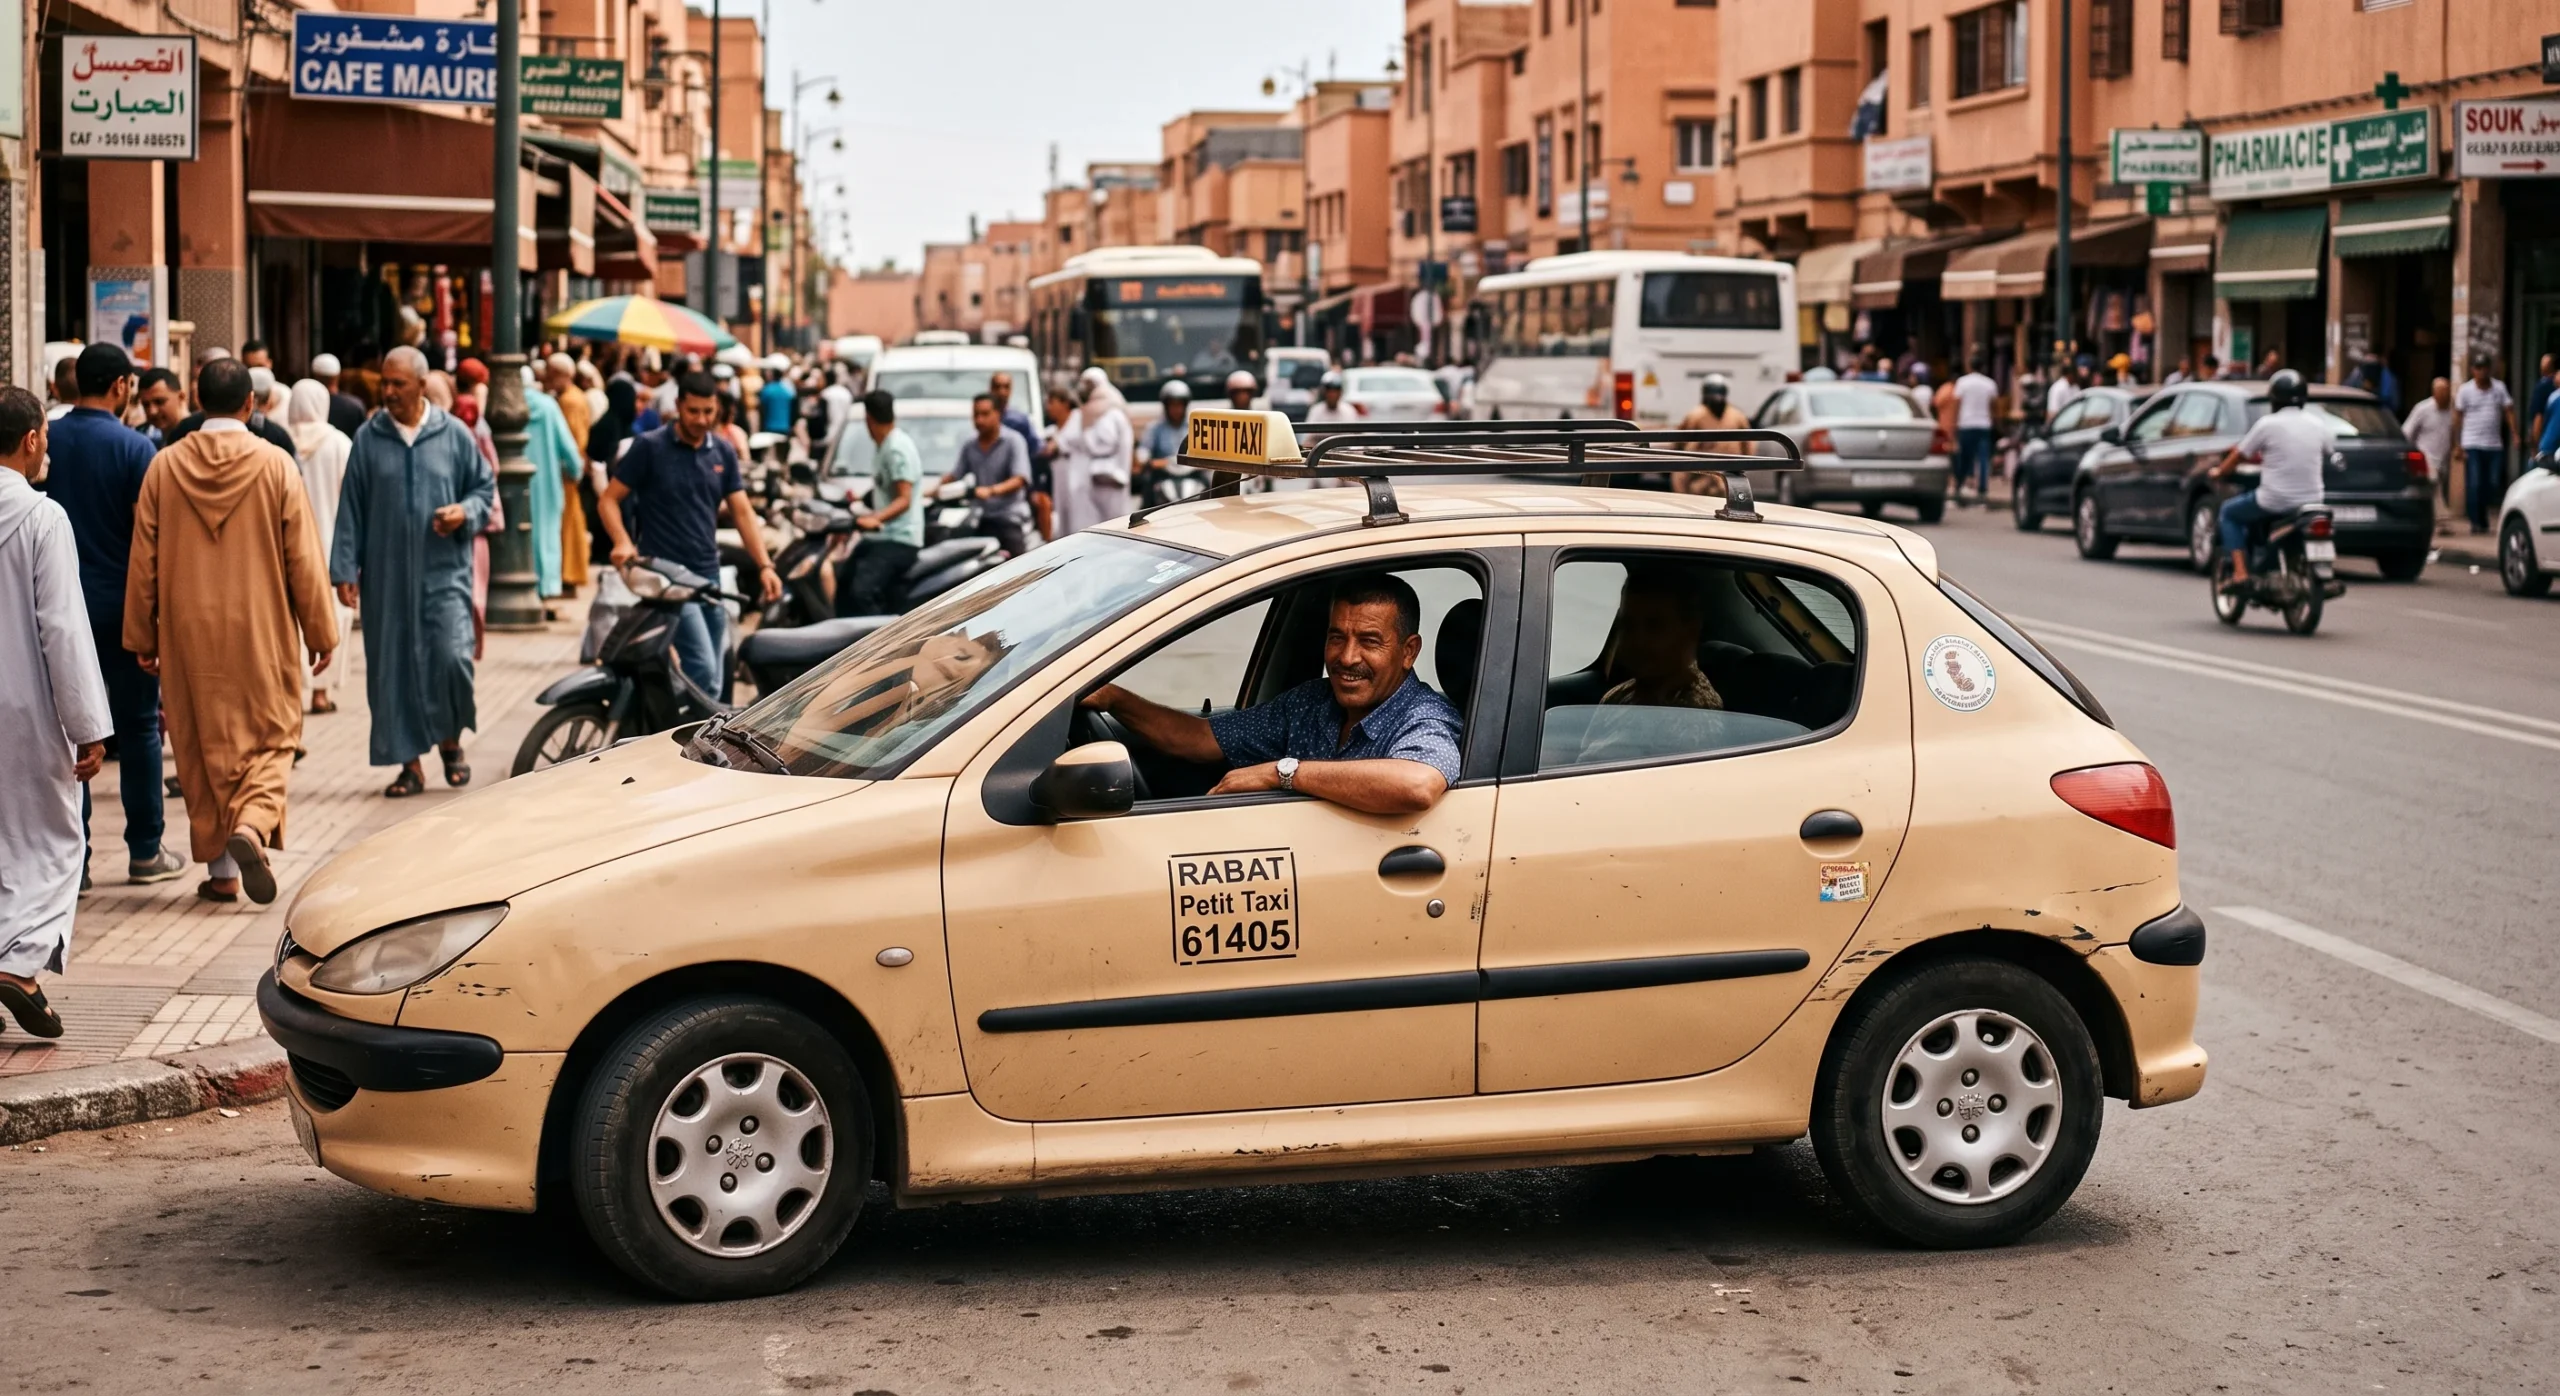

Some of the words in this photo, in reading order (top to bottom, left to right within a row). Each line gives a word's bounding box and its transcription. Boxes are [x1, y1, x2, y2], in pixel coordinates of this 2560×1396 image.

[301, 59, 383, 93] CAFE
[2466, 107, 2525, 134] SOUK
[2212, 127, 2328, 179] PHARMACIE
[1193, 418, 1229, 452] PETIT
[1232, 421, 1263, 456] TAXI
[1178, 856, 1284, 886] RABAT
[1180, 892, 1234, 916] Petit
[1241, 888, 1289, 912] Taxi
[1182, 919, 1291, 957] 61405
